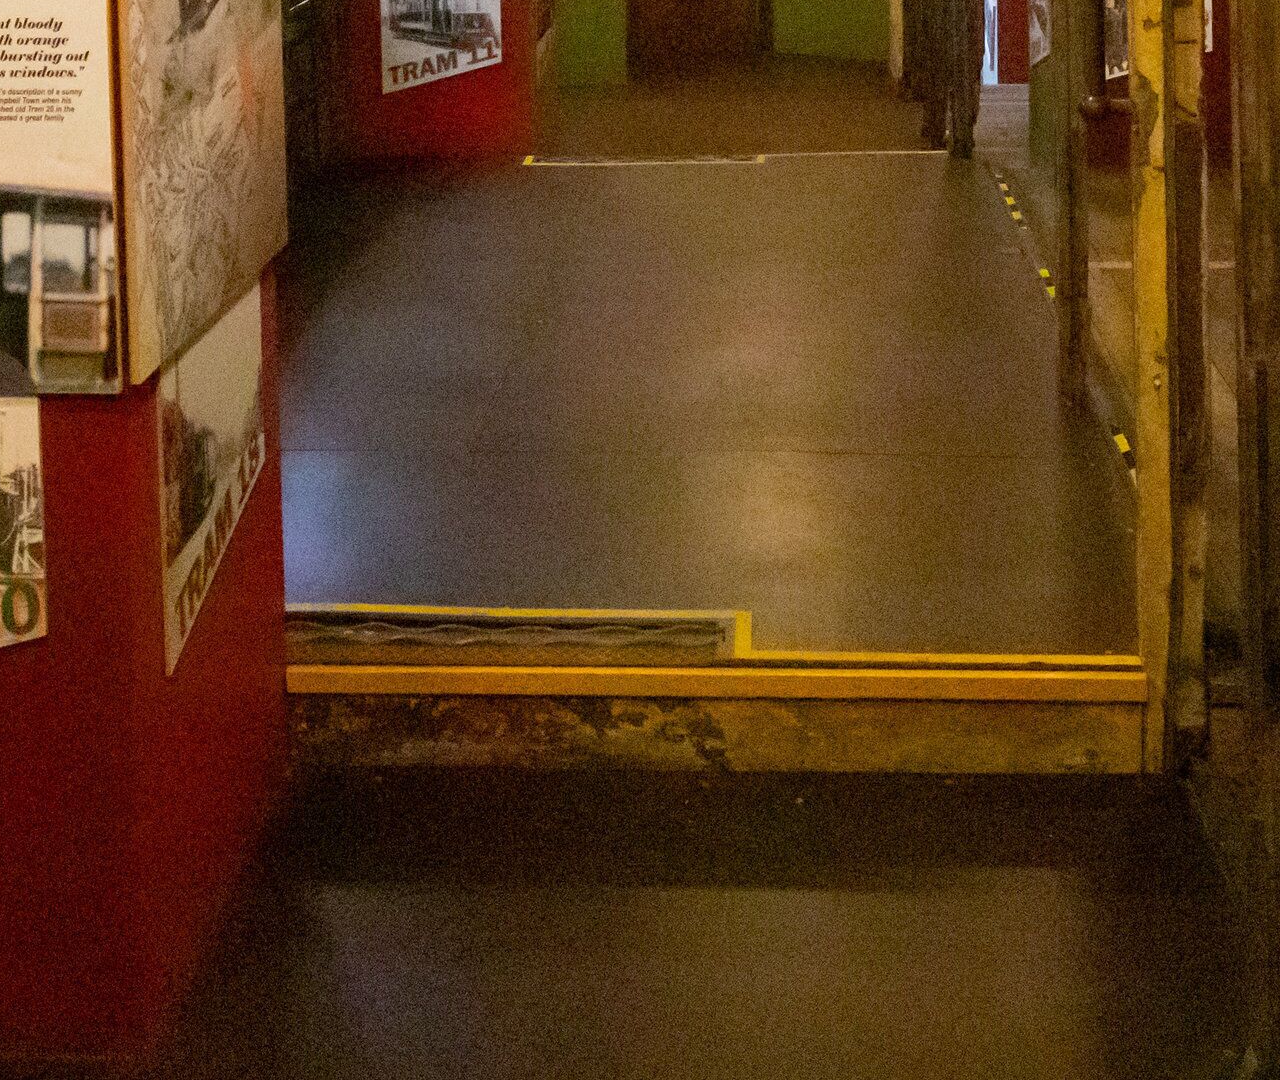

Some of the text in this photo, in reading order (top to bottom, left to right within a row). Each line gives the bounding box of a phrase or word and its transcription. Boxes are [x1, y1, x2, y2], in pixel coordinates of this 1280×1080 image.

[13, 17, 63, 32] bloody
[16, 35, 69, 48] orange
[0, 50, 63, 64] bursting
[65, 50, 90, 61] out
[388, 41, 499, 85] TRAM 11
[9, 65, 85, 78] windows."
[175, 487, 233, 640] TRAM
